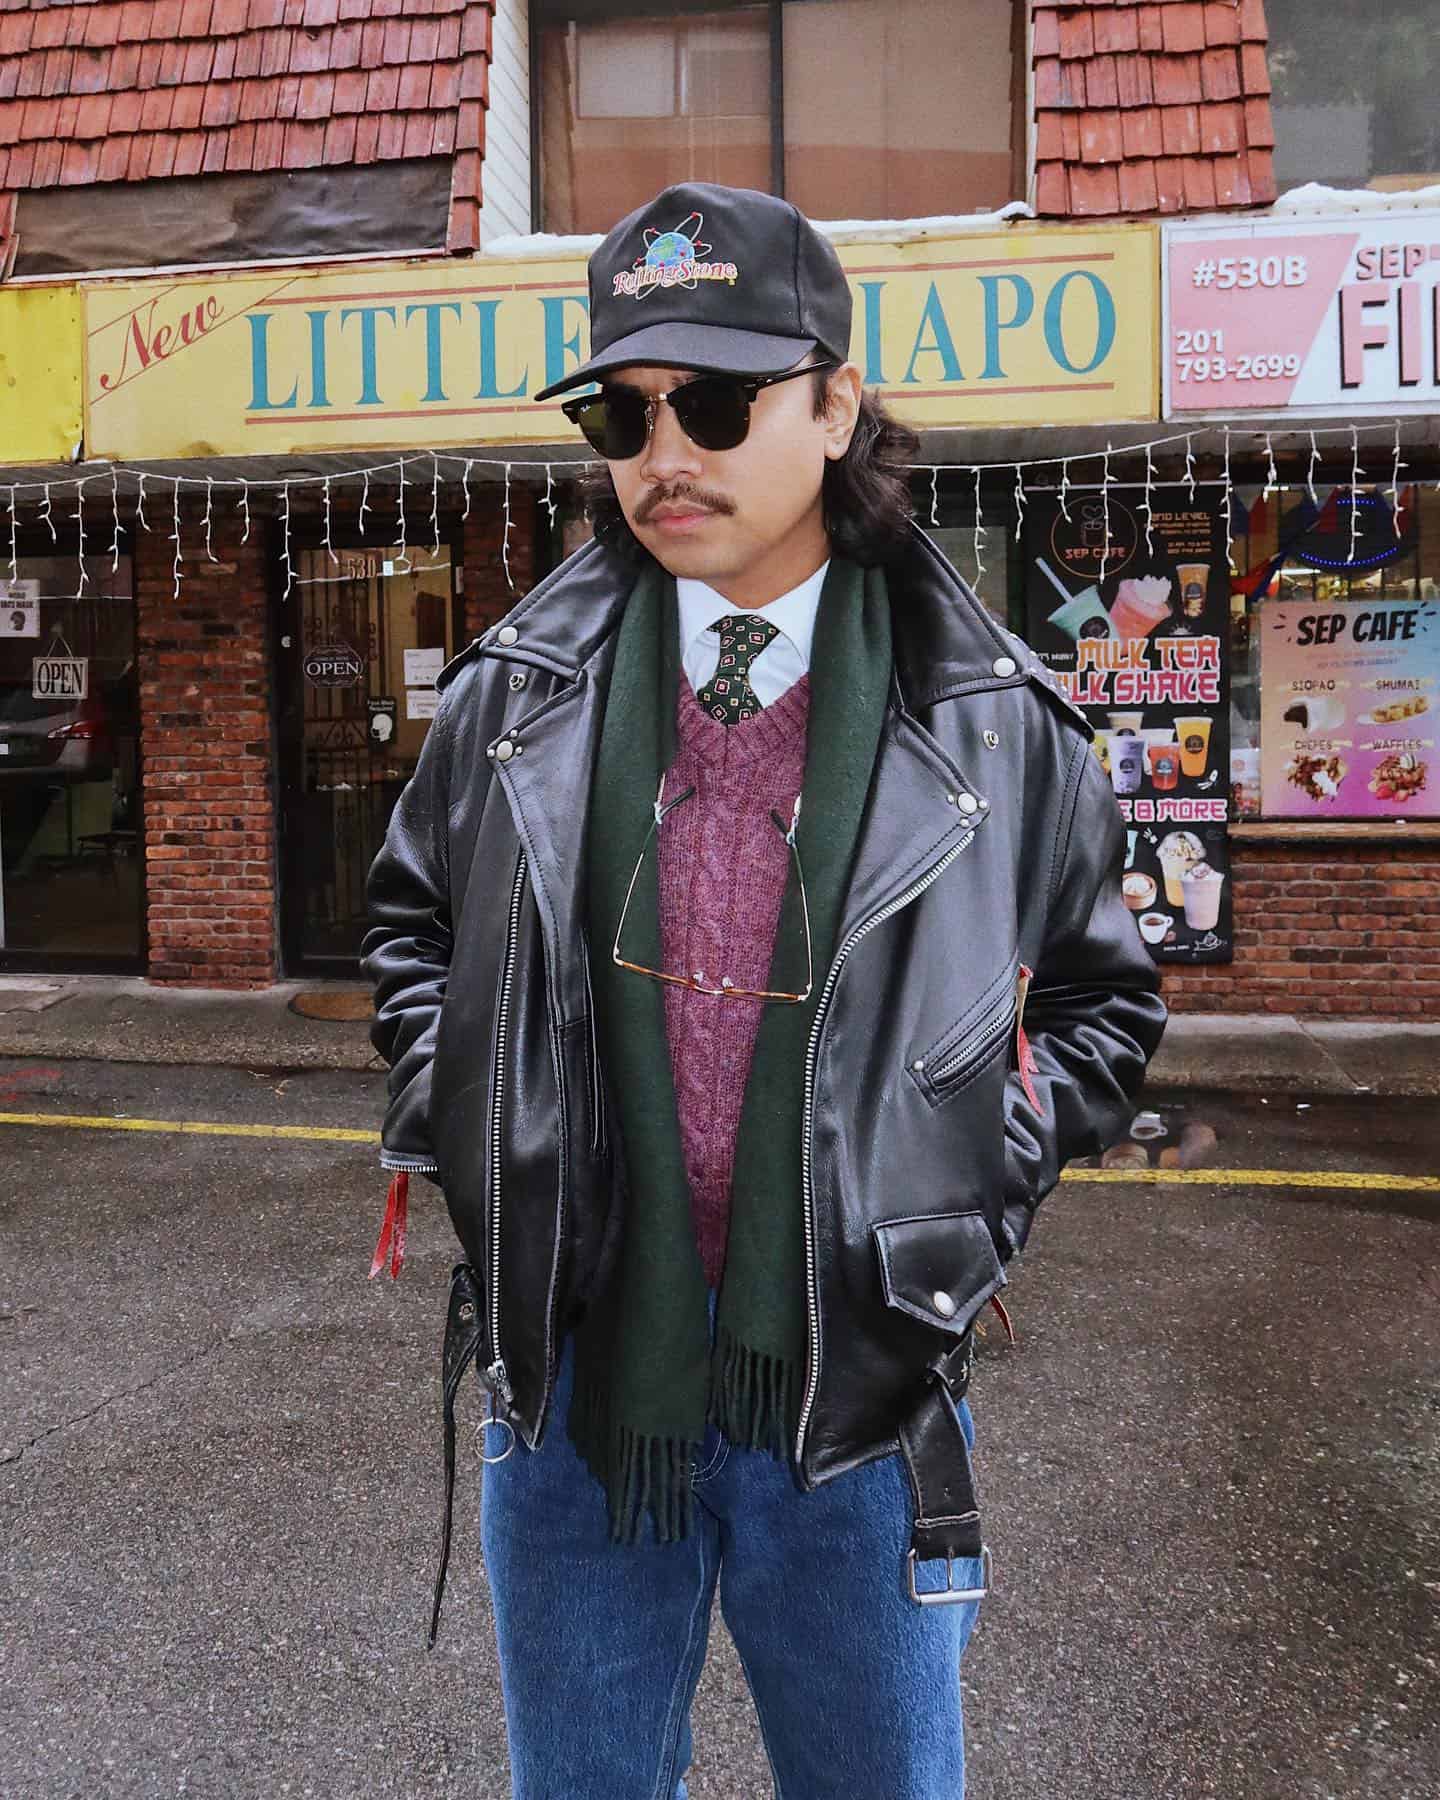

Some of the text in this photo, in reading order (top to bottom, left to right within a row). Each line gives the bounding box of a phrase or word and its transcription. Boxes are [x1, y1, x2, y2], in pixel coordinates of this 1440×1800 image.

[612, 258, 739, 297] Rolling Stone
[1193, 256, 1307, 290] #530B
[1355, 244, 1440, 281] SEP
[100, 295, 224, 390] New
[245, 270, 1117, 410] LITTLE IAPO
[1175, 330, 1224, 355] 201
[1339, 281, 1440, 389] FI
[1175, 353, 1301, 382] 793-2699
[1175, 511, 1210, 520] LEVEL
[347, 558, 377, 579] 530
[1064, 547, 1126, 560] SEP CFE
[1296, 609, 1419, 646] SEP CAFE
[1077, 635, 1220, 672] MILK TEA
[37, 662, 83, 694] OPEN
[307, 662, 359, 676] OPEN
[1055, 671, 1220, 704] ILK SHAKE
[1292, 680, 1336, 691] SIOPAO
[1375, 679, 1420, 691] SHUMAI
[1373, 739, 1424, 750] WAFFLES
[1158, 799, 1227, 822] MORE
